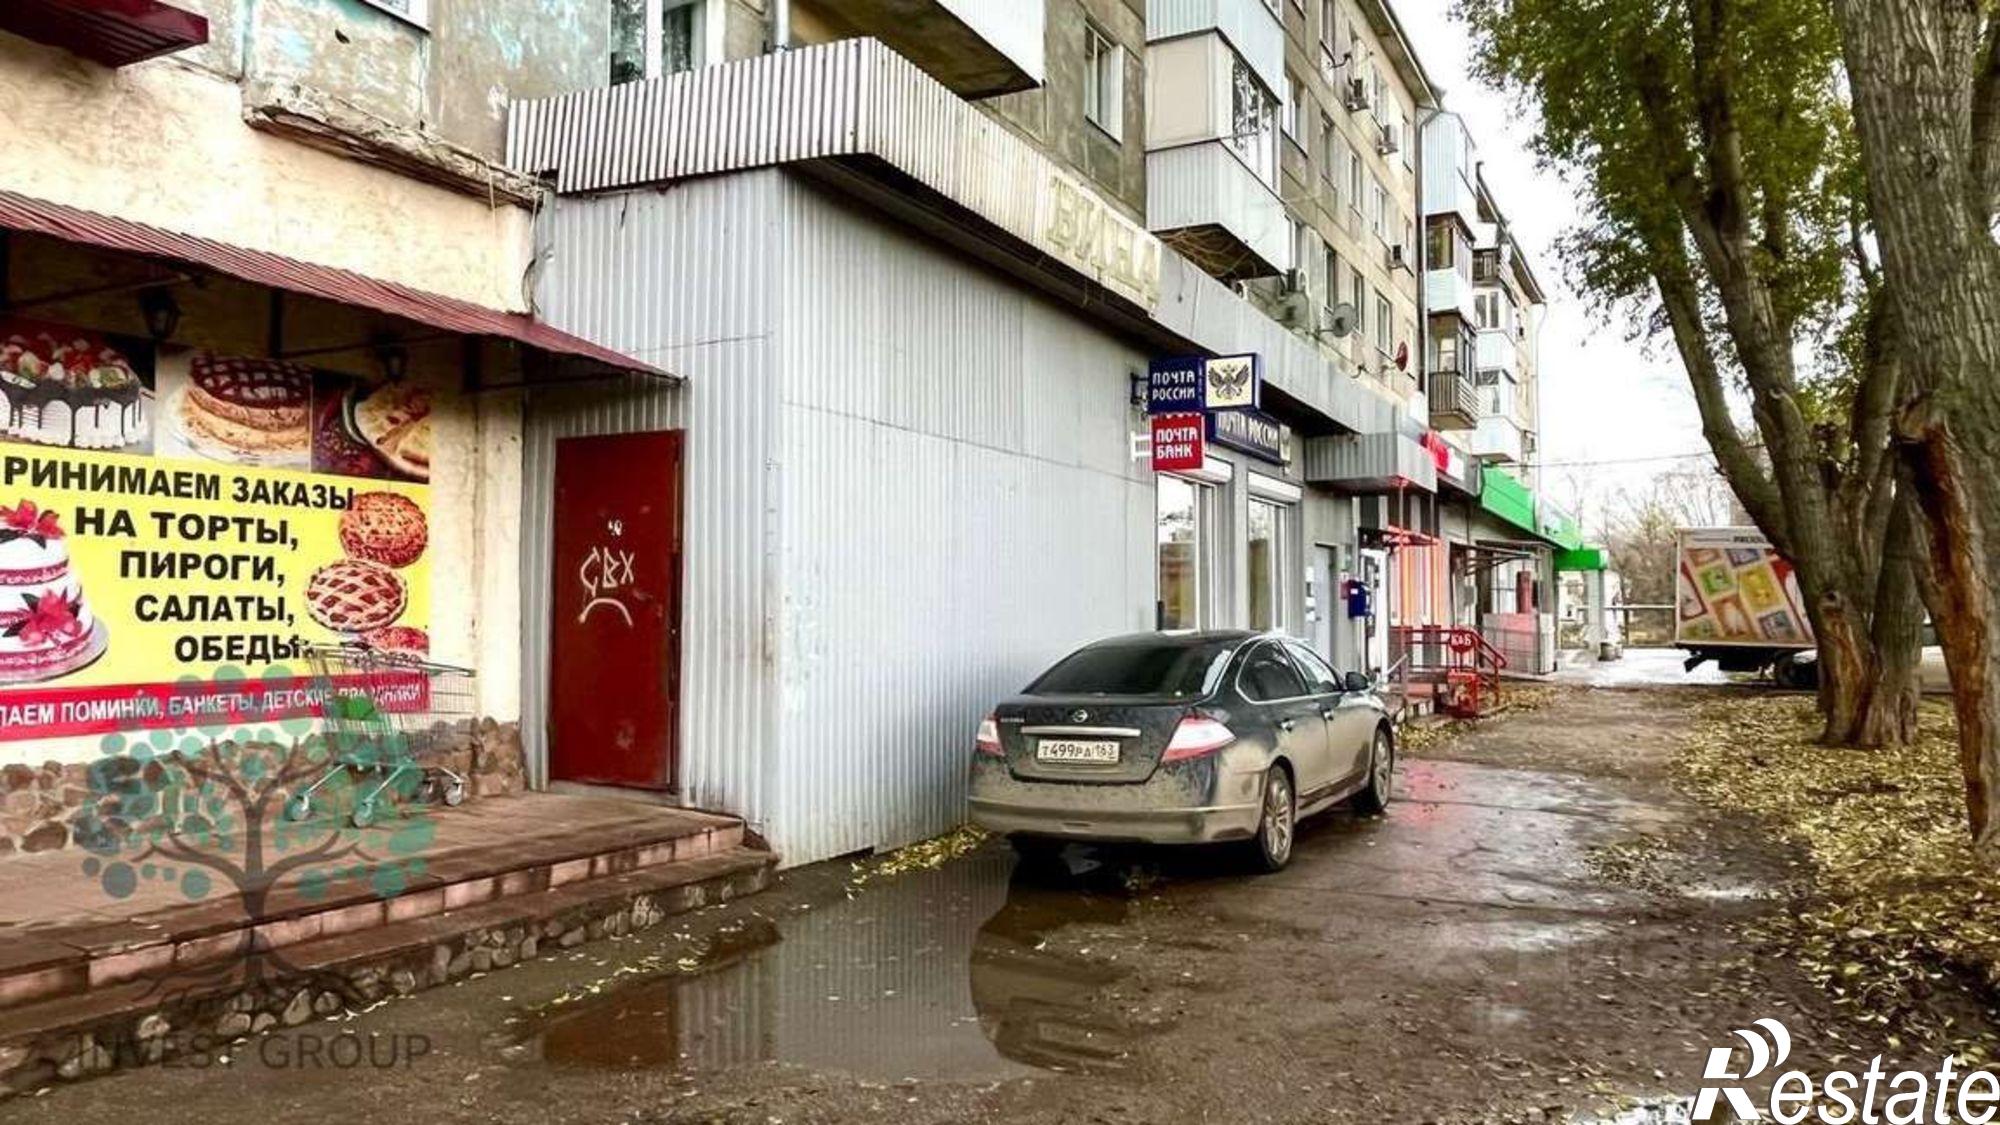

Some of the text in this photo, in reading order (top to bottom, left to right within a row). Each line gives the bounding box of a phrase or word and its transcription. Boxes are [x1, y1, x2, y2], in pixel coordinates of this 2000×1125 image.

[1152, 370, 1195, 385] ПОЧТА
[1152, 386, 1195, 401] РОССИИ
[1156, 426, 1198, 443] ПОЧТА
[1156, 443, 1193, 459] БАНК
[1248, 416, 1279, 451] РОССИИ
[5, 456, 354, 510] РИНИМАЕМ ЗАКАЗЫ
[75, 506, 298, 550] НА ТОРТЫ,
[120, 550, 285, 587] ПИРОГИ,
[580, 546, 635, 597] СВХ
[135, 594, 294, 626] САЛАТЫ,
[61, 697, 164, 724] ПОМИНКИ,
[260, 689, 332, 713] ДЕТСКИЕ
